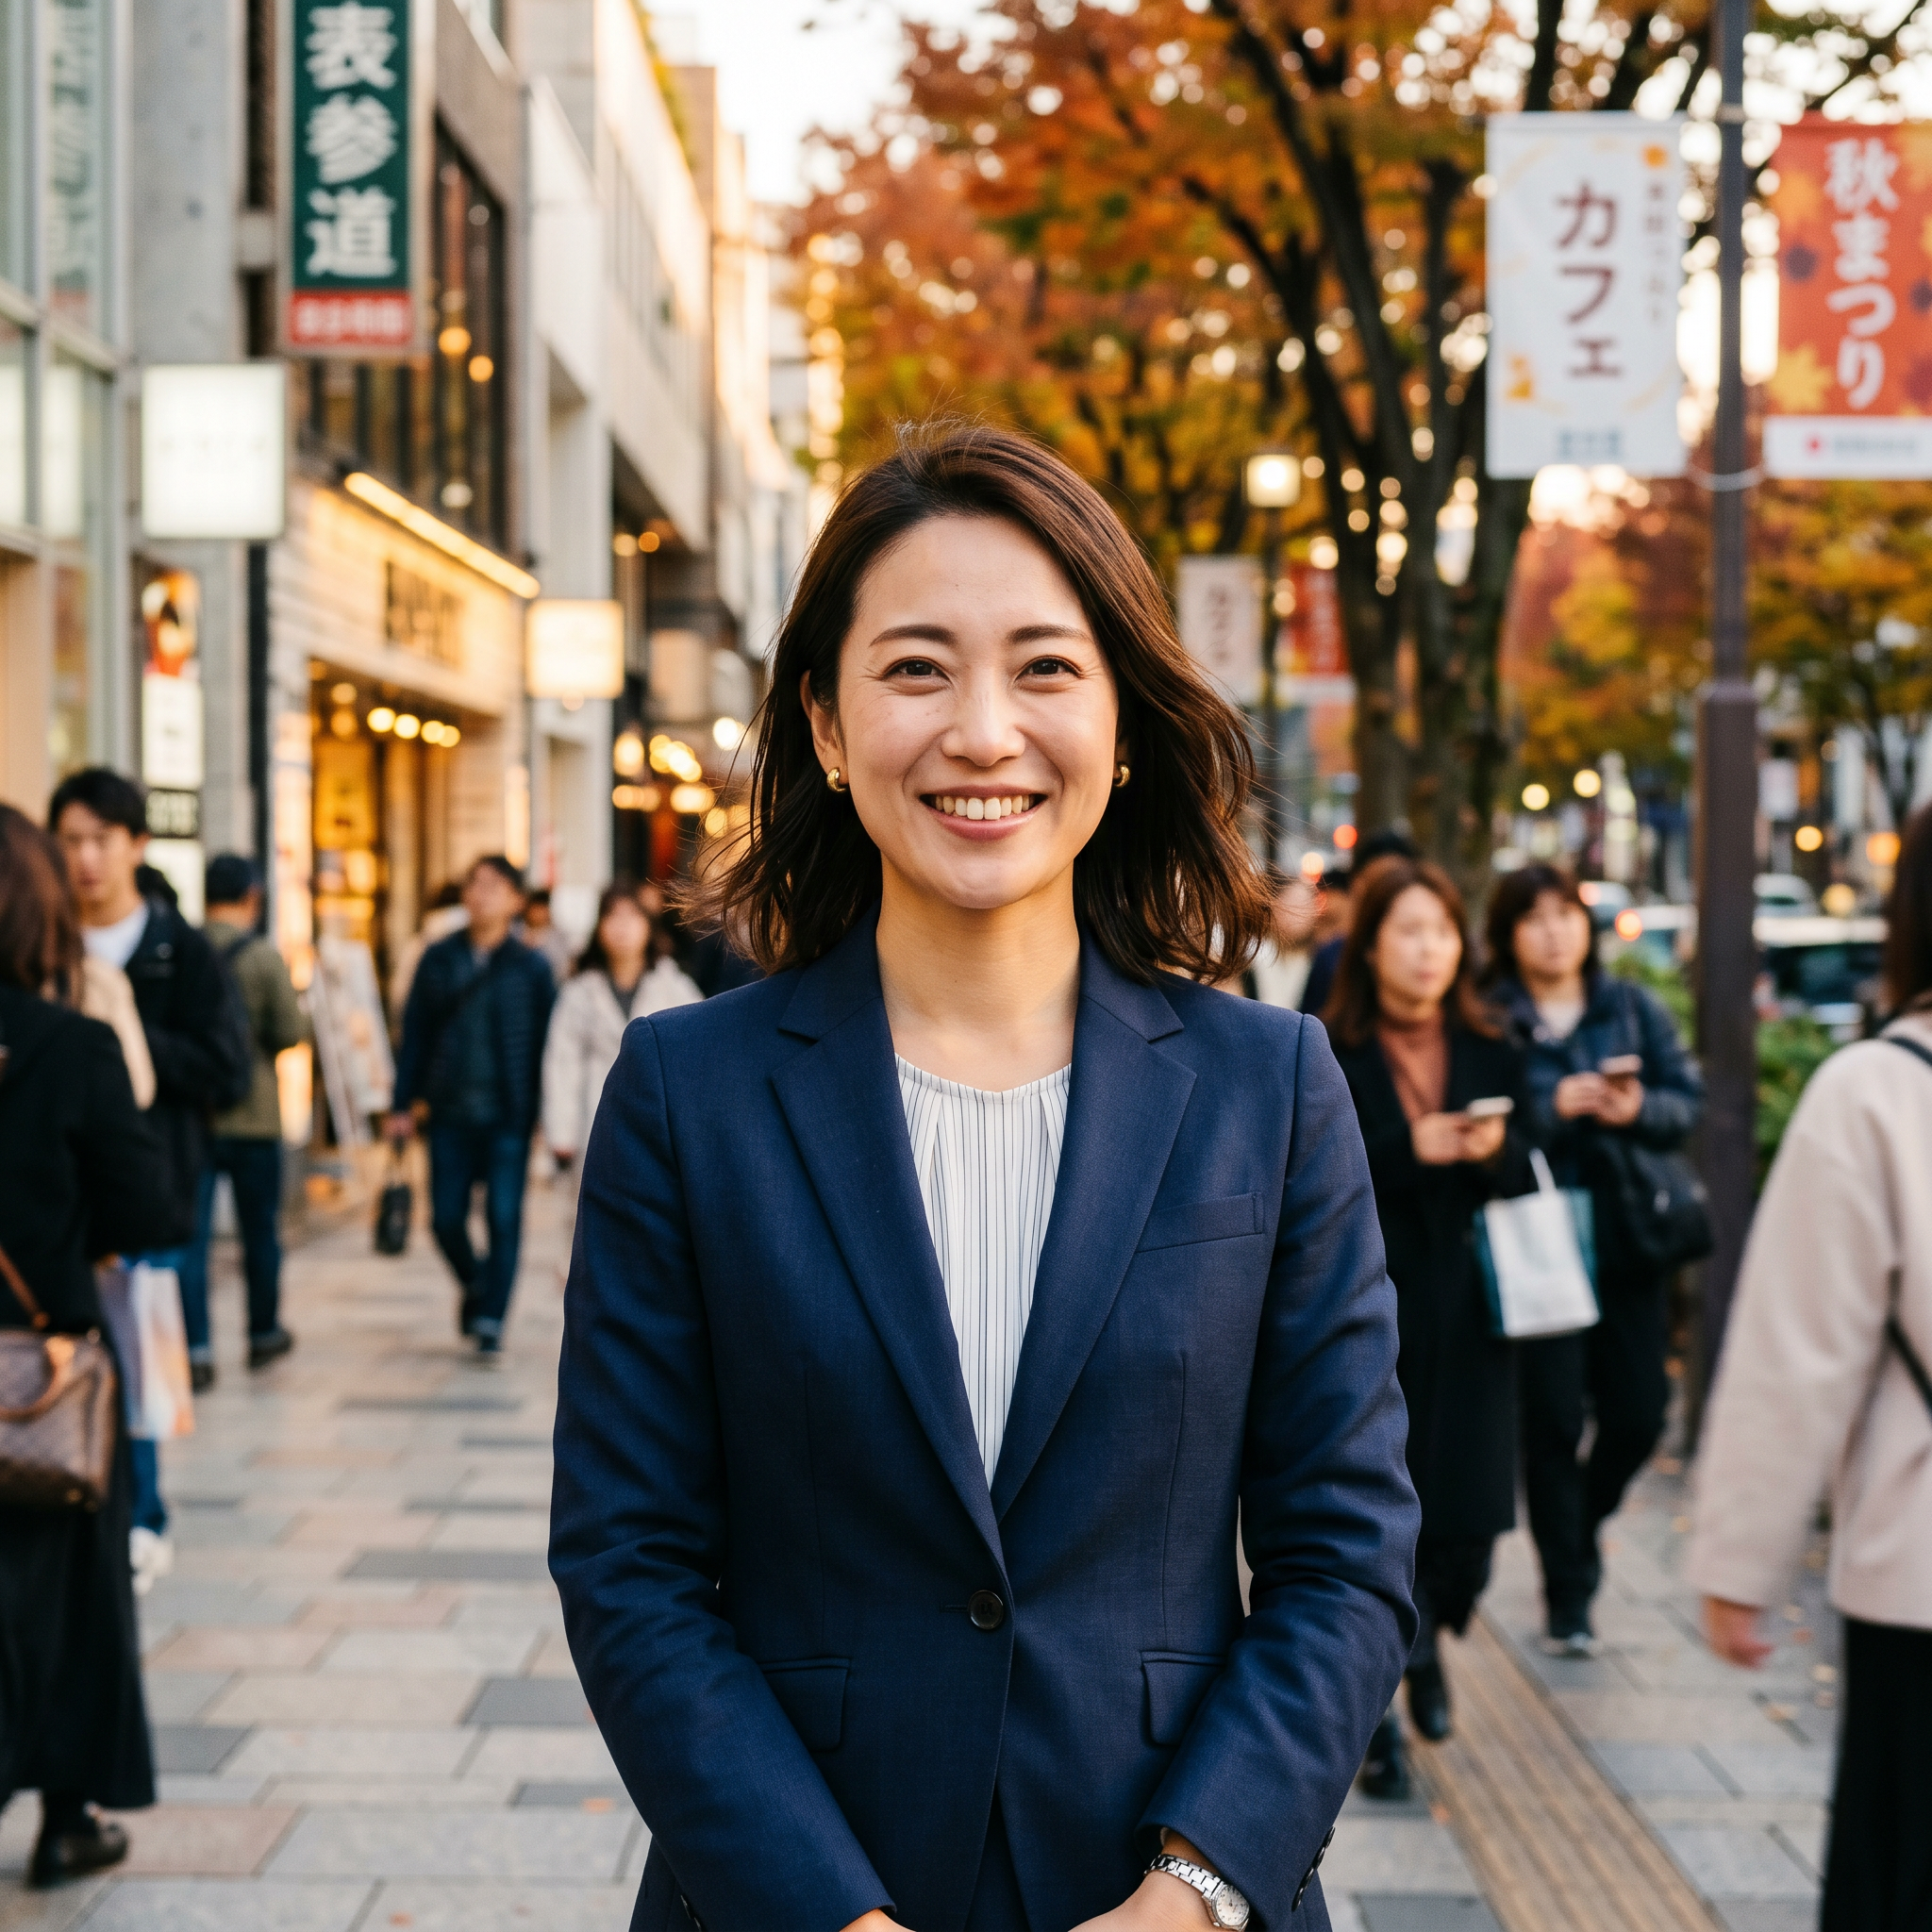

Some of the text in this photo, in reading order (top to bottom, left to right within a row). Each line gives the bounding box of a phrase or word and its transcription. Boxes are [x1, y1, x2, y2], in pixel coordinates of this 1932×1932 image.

[306, 1, 397, 277] 表参道
[1555, 182, 1624, 379] カフェ
[1824, 140, 1899, 408] 秋まつり
